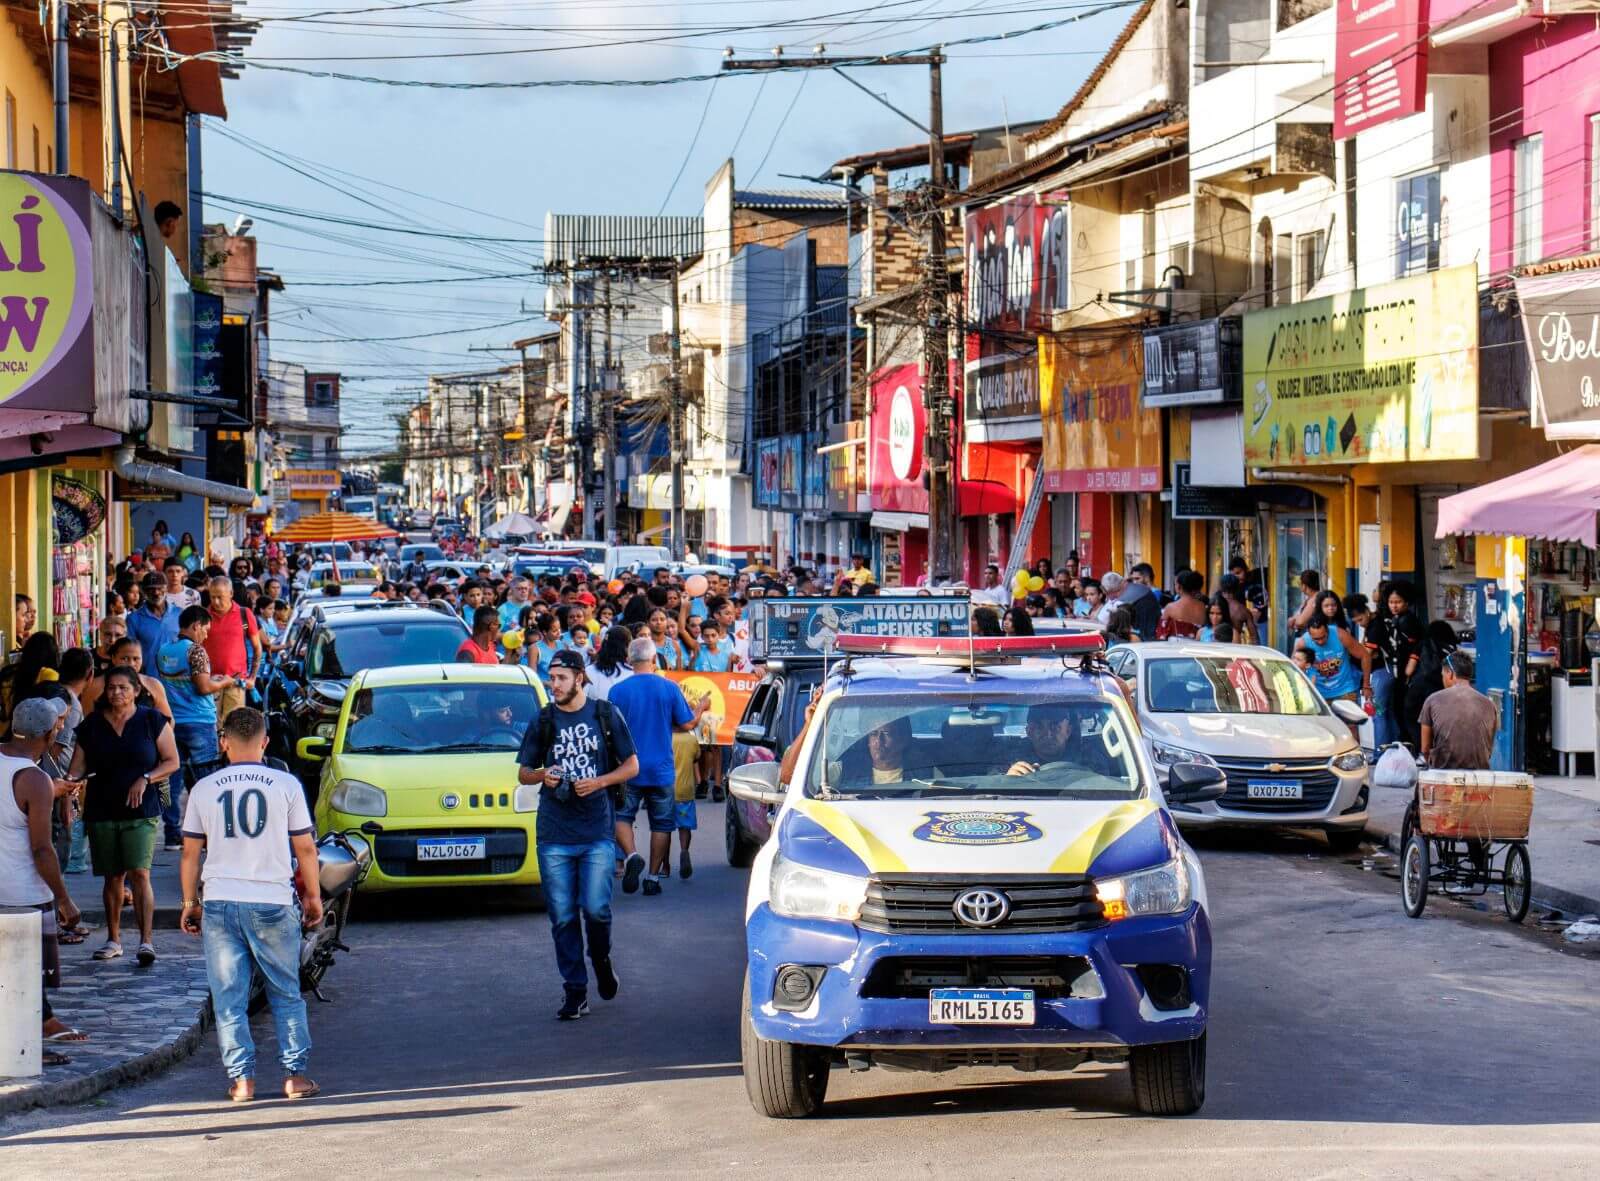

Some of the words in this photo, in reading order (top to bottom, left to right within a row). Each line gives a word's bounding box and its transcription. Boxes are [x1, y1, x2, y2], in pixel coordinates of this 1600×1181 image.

[1303, 371, 1331, 397] MATERIAL
[1333, 371, 1341, 393] DE
[774, 604, 791, 618] 10
[877, 622, 934, 637] PEIXES
[727, 679, 760, 691] ABU
[560, 723, 589, 744] NO
[553, 735, 599, 760] PAIN
[561, 753, 590, 773] NO
[215, 773, 274, 787] TOTTENHAM
[570, 764, 598, 782] AIN
[216, 788, 269, 839] 10
[423, 845, 477, 858] NZL9C67
